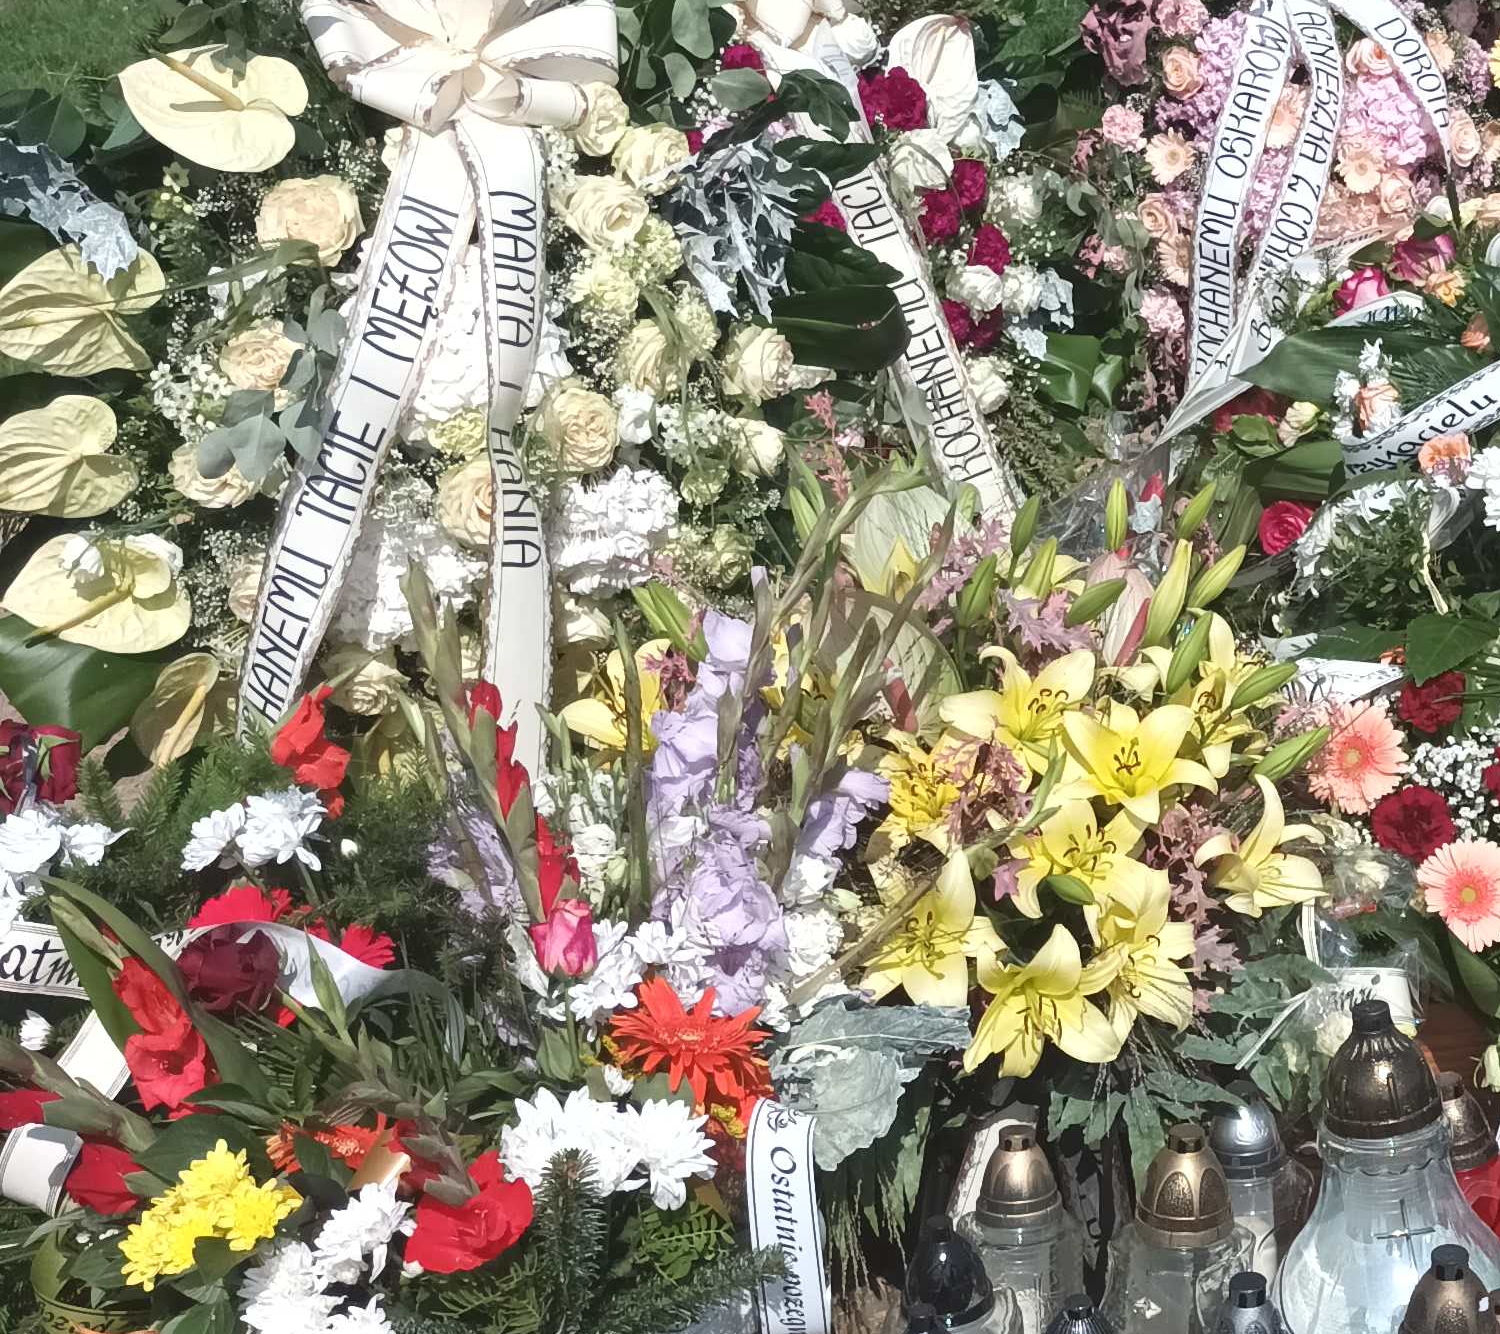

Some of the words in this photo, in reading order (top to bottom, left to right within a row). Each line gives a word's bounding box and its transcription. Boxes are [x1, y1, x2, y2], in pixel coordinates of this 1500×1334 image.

[1293, 8, 1341, 165] AGNIESZKA
[1372, 17, 1450, 129] DOROTA
[490, 191, 537, 350] MARTA
